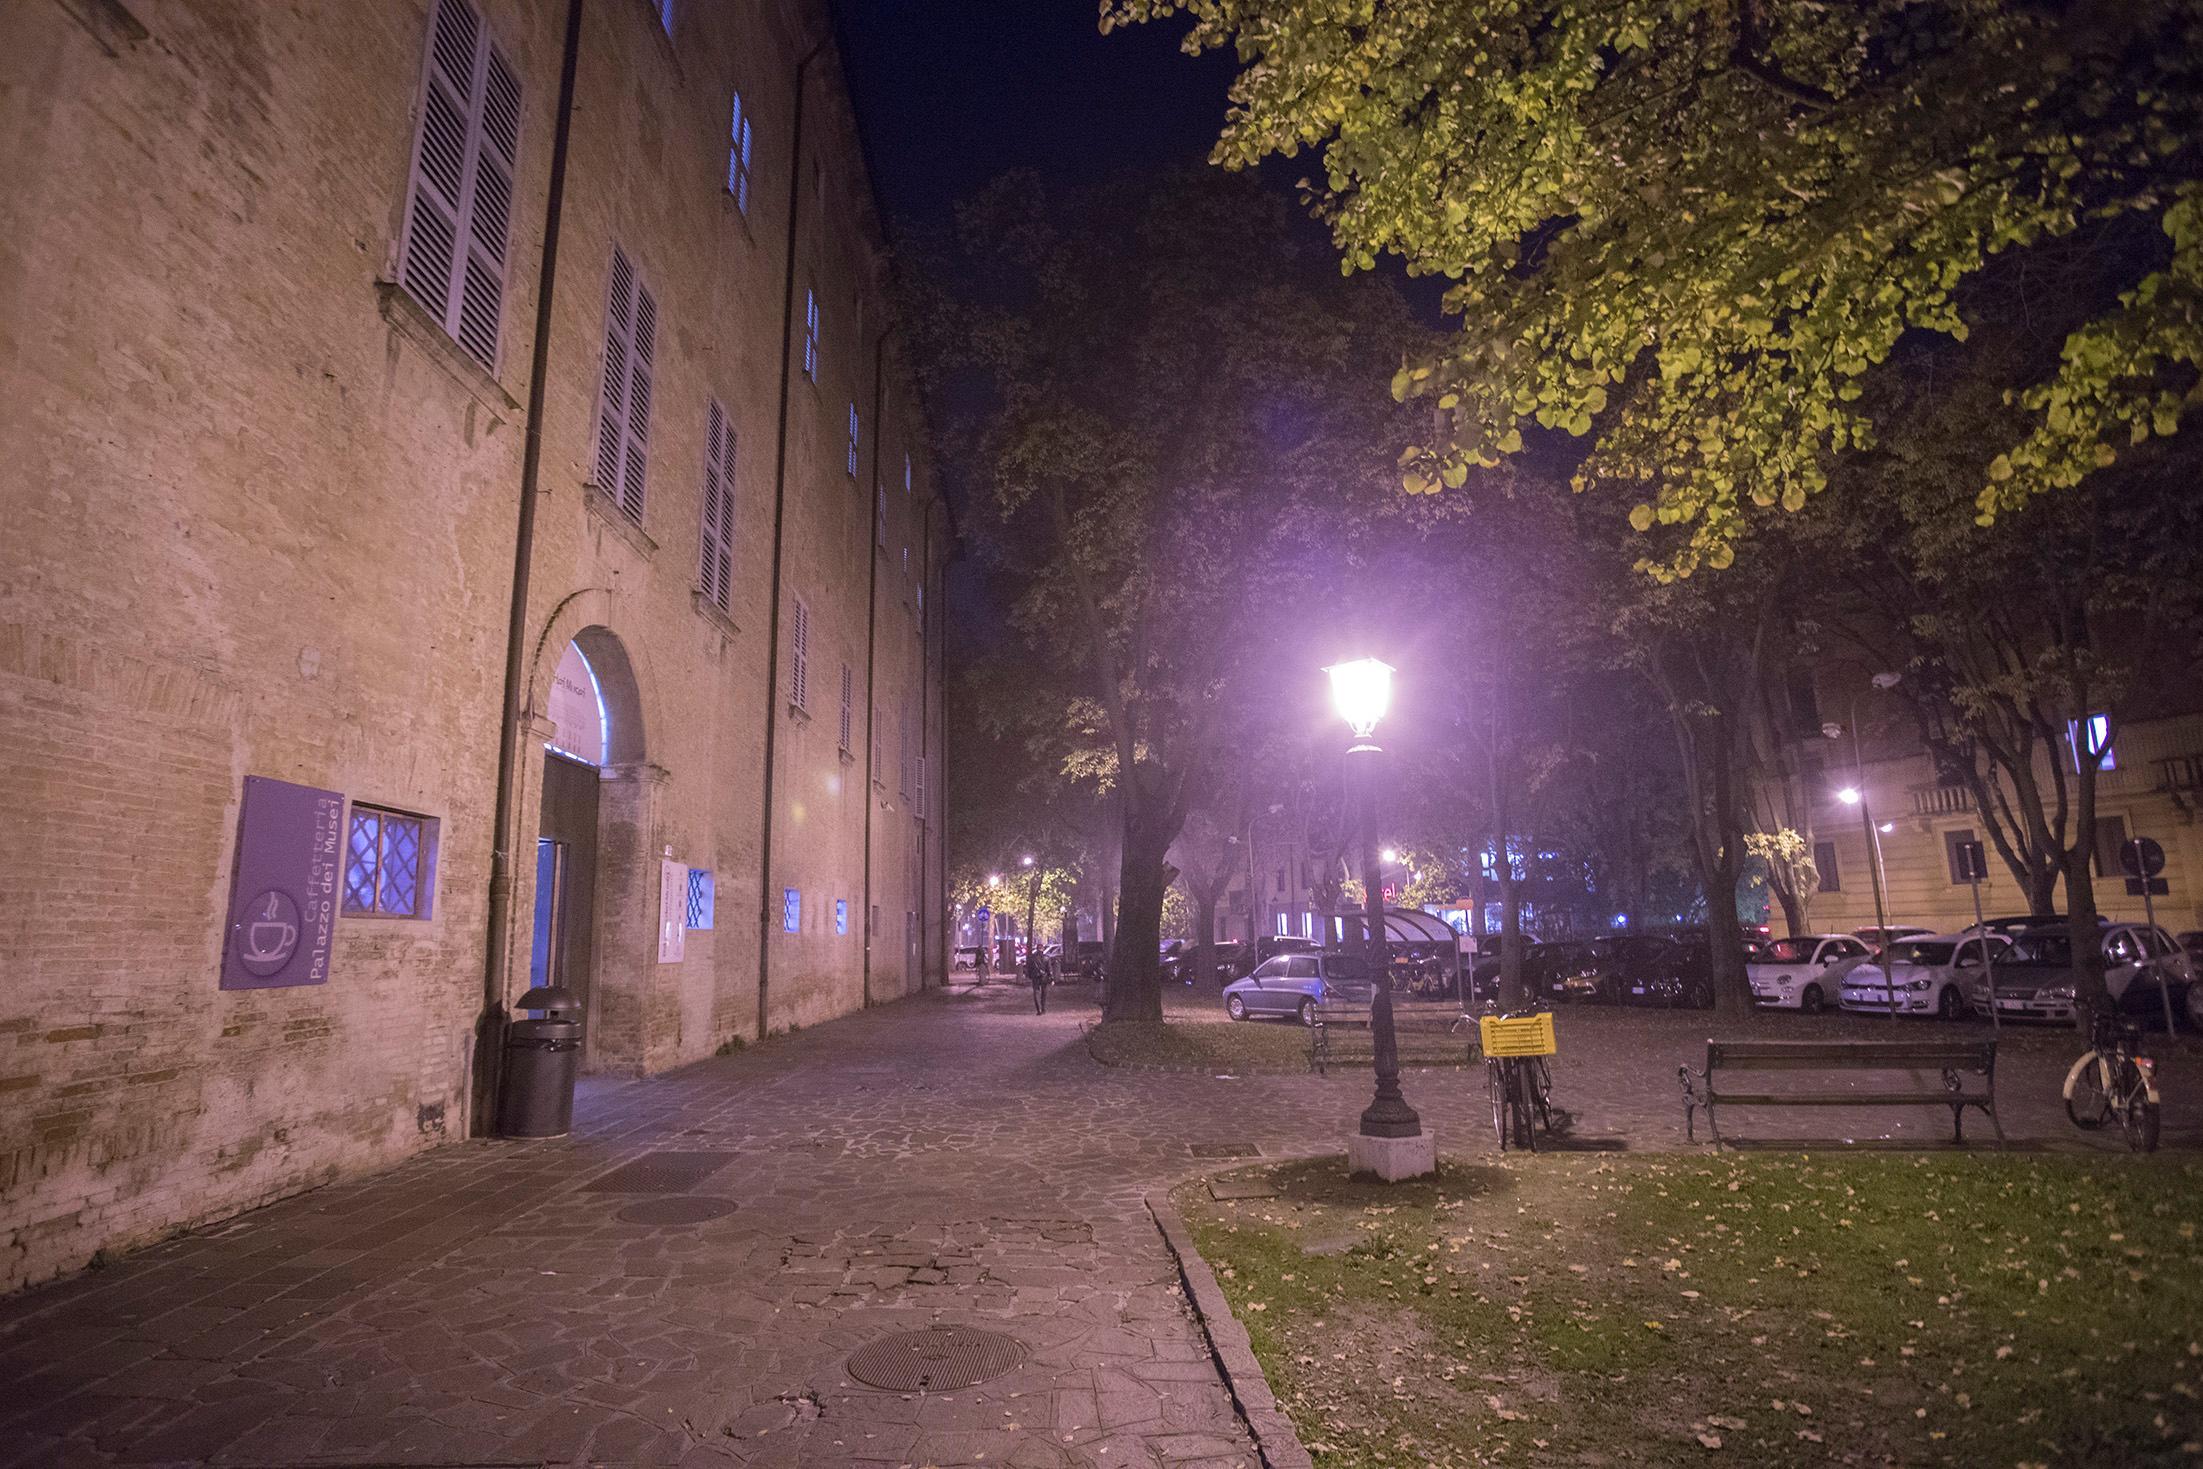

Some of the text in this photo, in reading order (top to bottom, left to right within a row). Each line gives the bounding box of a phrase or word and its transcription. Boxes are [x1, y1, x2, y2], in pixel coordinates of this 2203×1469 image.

[304, 798, 328, 923] Caffetteria
[310, 799, 340, 980] Palazzo dei Musei
